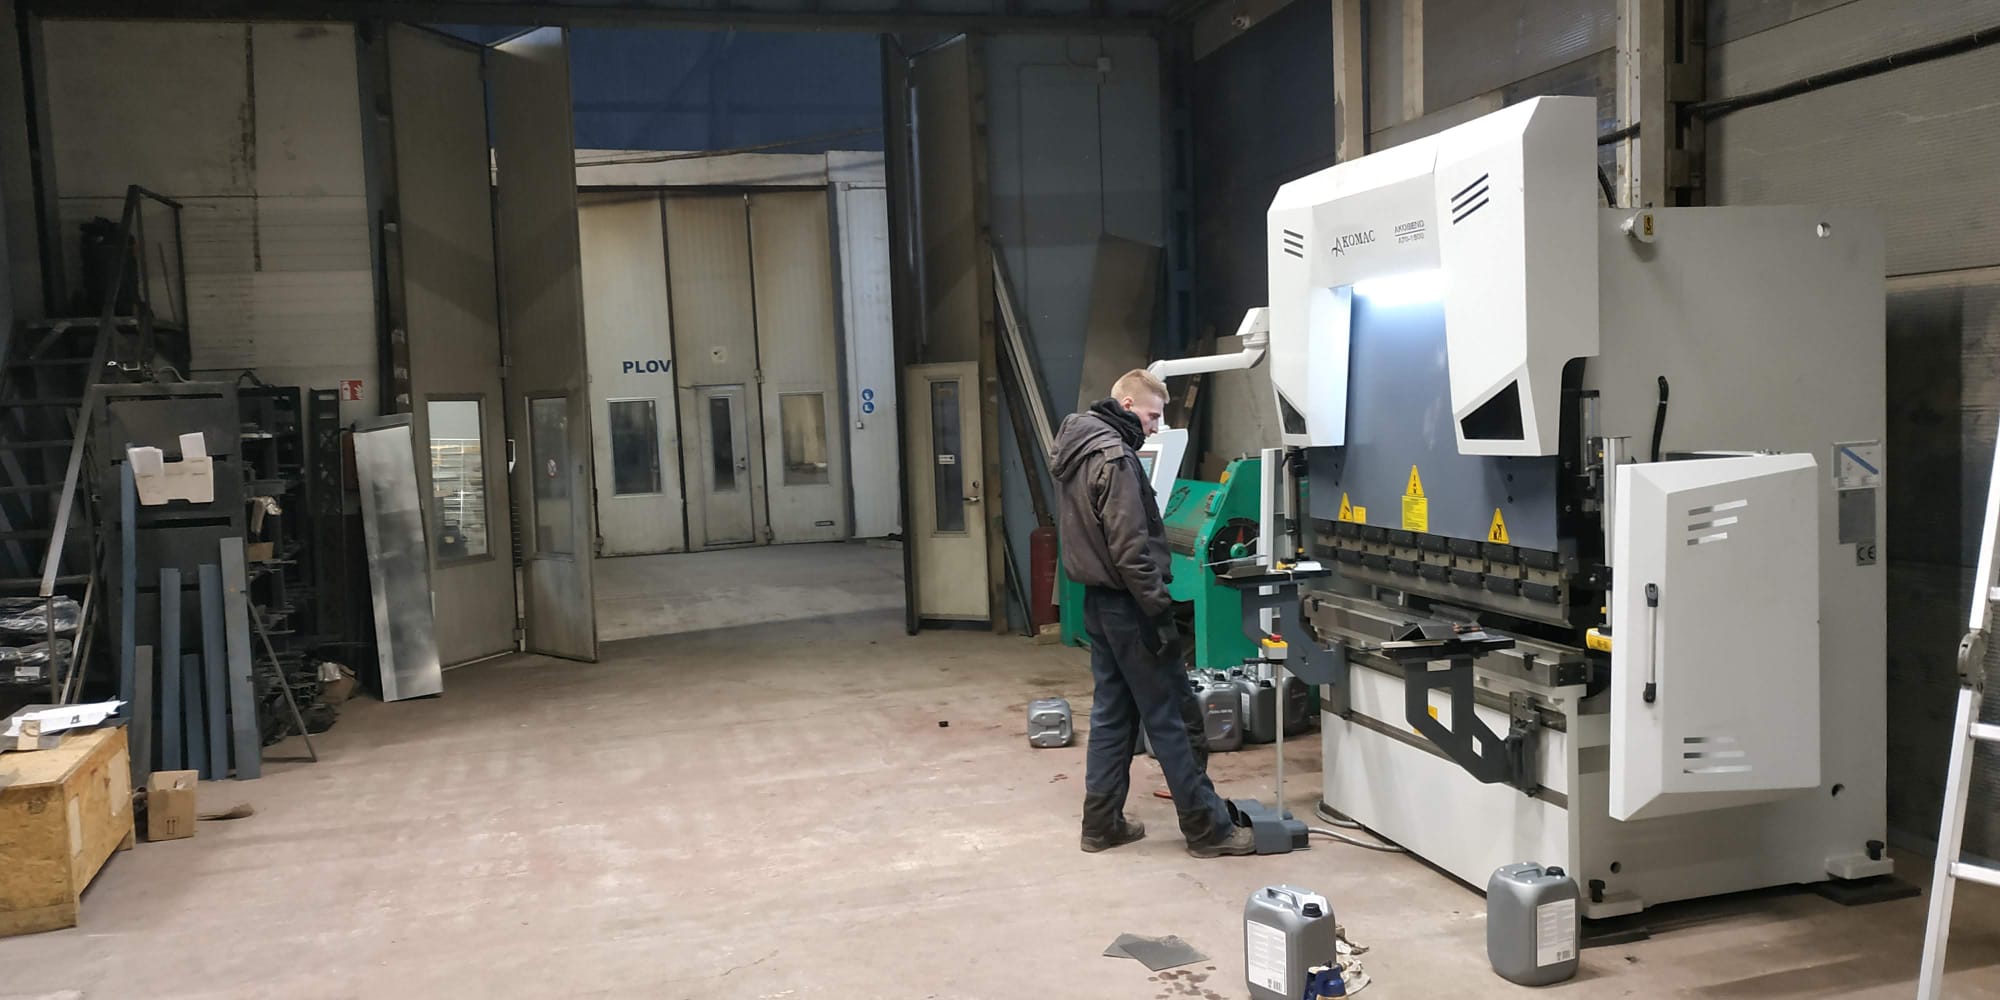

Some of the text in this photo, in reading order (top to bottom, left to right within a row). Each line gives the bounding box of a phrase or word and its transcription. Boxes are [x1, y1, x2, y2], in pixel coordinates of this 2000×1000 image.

[1331, 229, 1376, 257] AKOMAC
[622, 359, 672, 374] PLOV
[1857, 545, 1876, 561] CE
